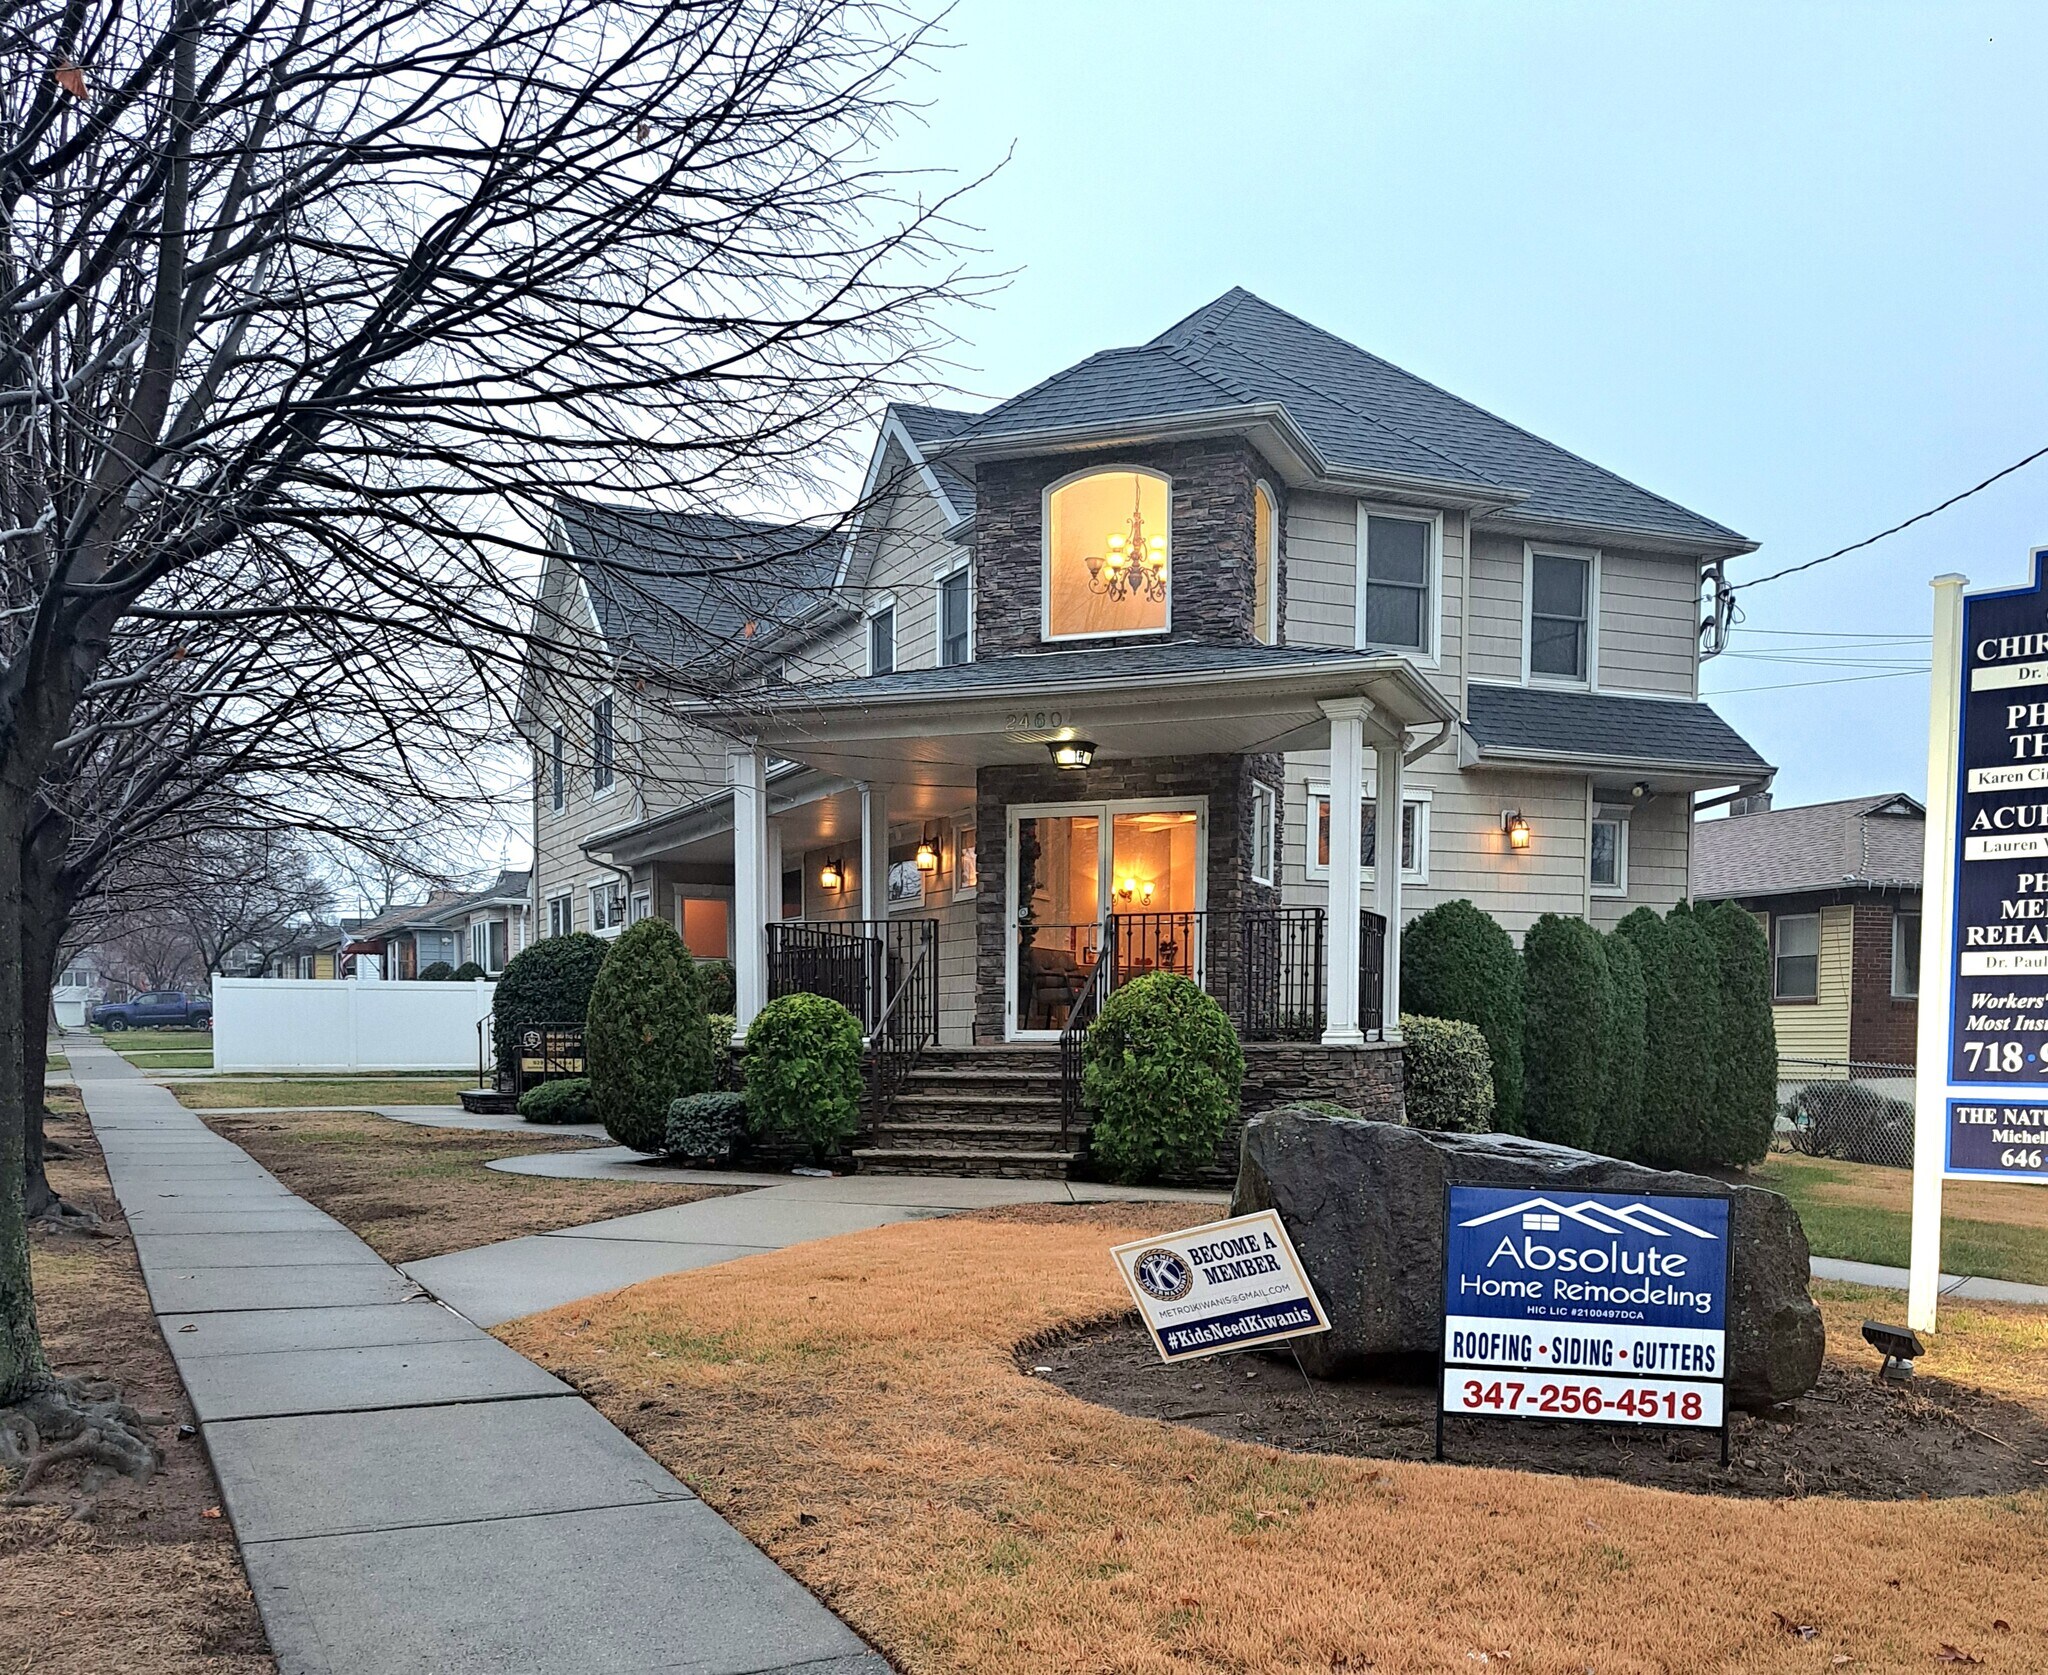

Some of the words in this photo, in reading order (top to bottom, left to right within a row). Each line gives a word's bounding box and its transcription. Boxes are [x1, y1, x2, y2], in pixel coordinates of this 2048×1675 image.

[2019, 667, 2041, 680] Dr.
[1005, 711, 1062, 730] 2460
[2005, 702, 2048, 730] PH
[2009, 733, 2048, 759] TH
[1978, 772, 2023, 785] Karen
[1983, 840, 2037, 853] Lauren
[2016, 873, 2048, 893] PH
[2000, 899, 2048, 919] ME
[1966, 924, 2048, 946] REHA
[1986, 956, 2008, 969] Dr.
[2015, 955, 2048, 968] Paul
[1964, 1015, 2011, 1031] Most
[1956, 1107, 1998, 1125] THE
[2001, 1148, 2042, 1168] 646
[1187, 1234, 1261, 1266] BECOME
[1264, 1231, 1278, 1250] A
[1486, 1235, 1688, 1278] Absolute
[1202, 1254, 1282, 1286] MEMBER
[1460, 1273, 1544, 1299] Home
[1554, 1277, 1712, 1314] Remodeling
[1527, 1305, 1547, 1315] HIC
[1549, 1306, 1568, 1316] LIC
[1571, 1308, 1645, 1320] #2100497DCA
[1167, 1306, 1312, 1350] #KidsNeedKiwanis
[1453, 1331, 1532, 1362] ROOFING
[1551, 1336, 1613, 1367] SIDING
[1632, 1341, 1716, 1372] GUTTERS
[1462, 1380, 1703, 1421] 347-256-4518
